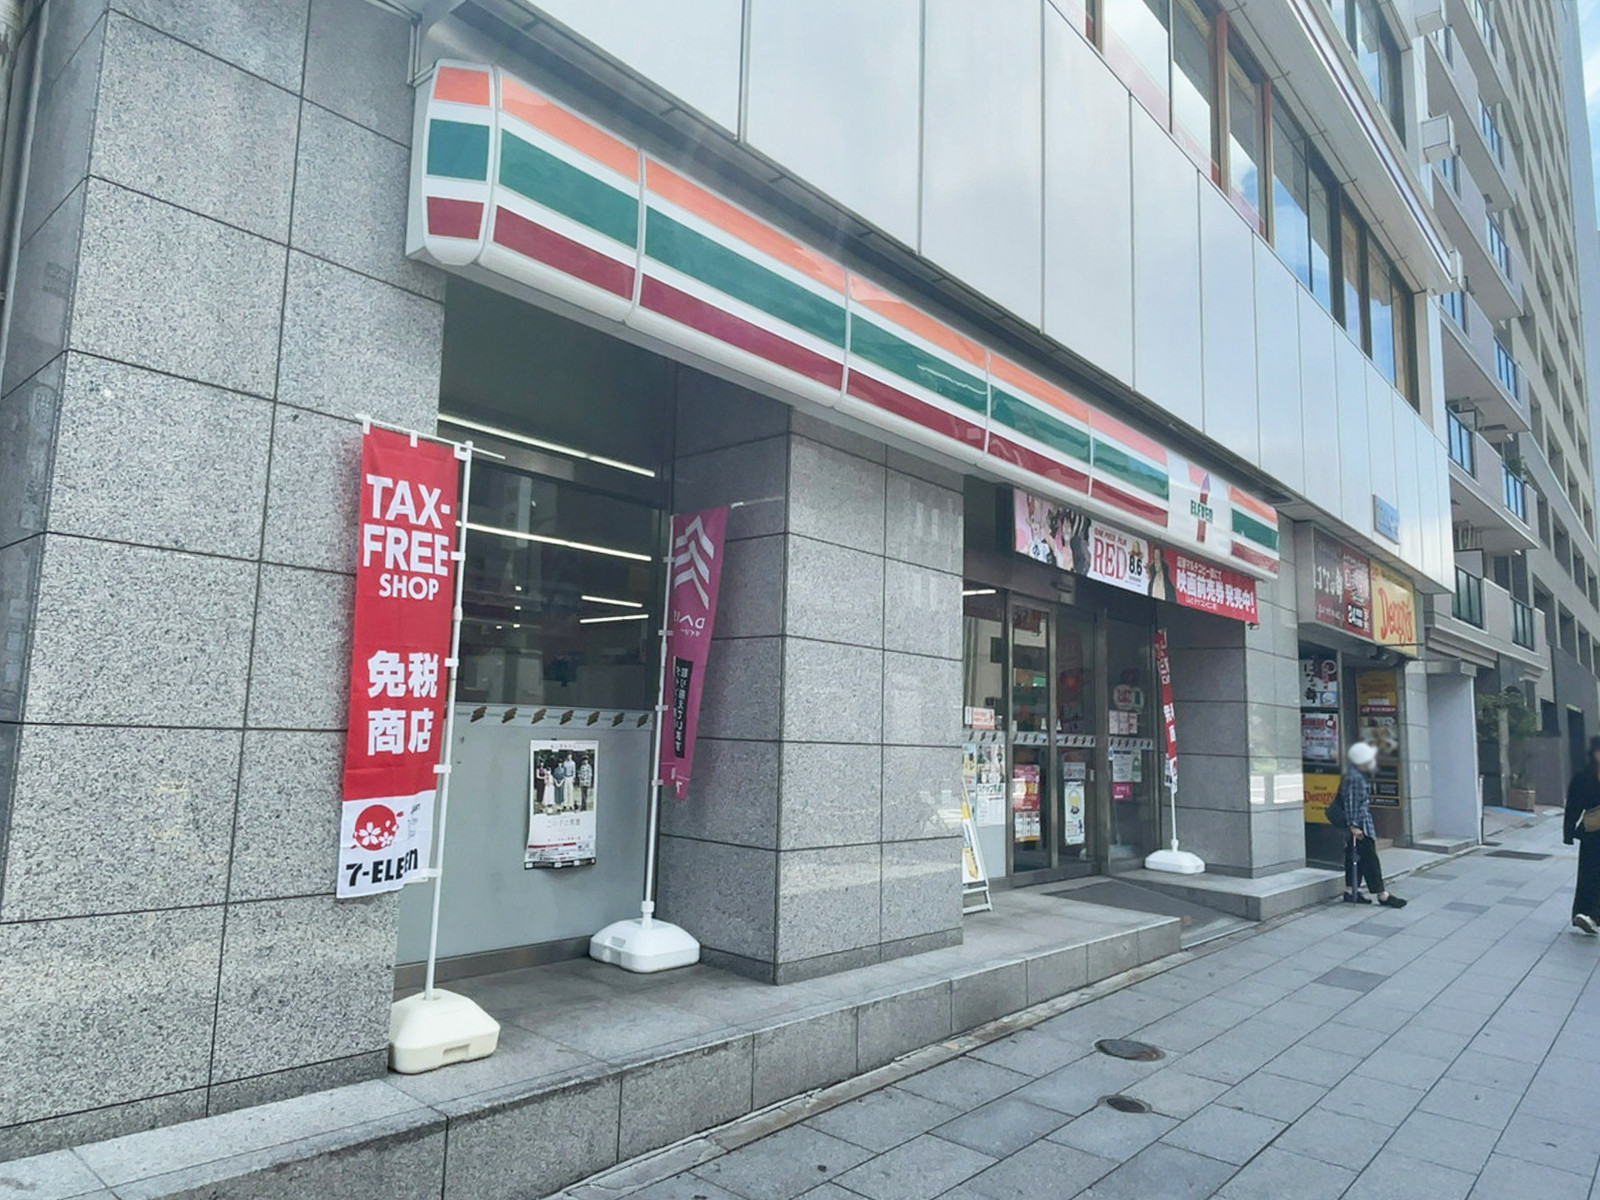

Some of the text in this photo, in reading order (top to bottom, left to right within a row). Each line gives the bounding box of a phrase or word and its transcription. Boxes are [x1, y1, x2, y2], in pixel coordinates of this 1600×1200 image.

[366, 473, 450, 529] TAX-
[363, 523, 449, 576] FREE
[1094, 537, 1127, 580] RED
[1129, 555, 1143, 577] 8.6
[378, 573, 439, 600] SHOP
[367, 650, 439, 698] 免税
[367, 708, 434, 756] 商店
